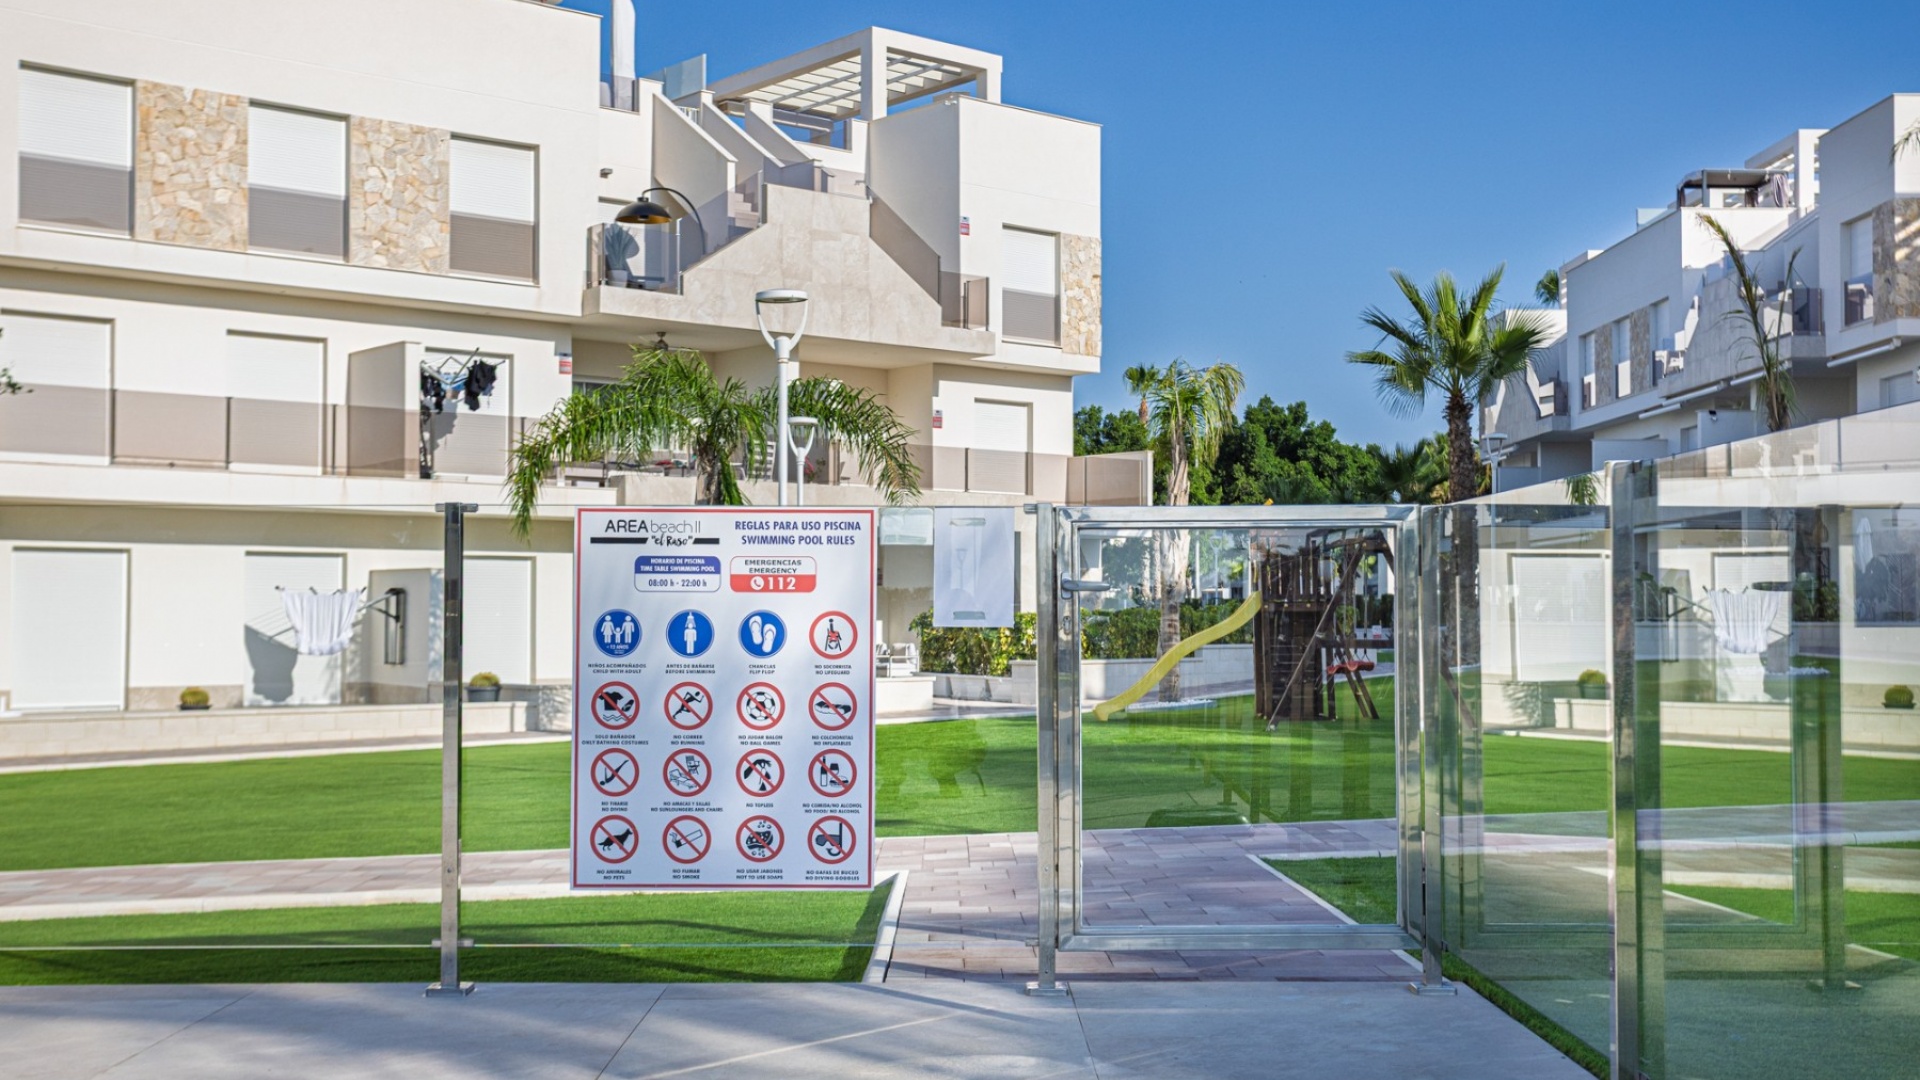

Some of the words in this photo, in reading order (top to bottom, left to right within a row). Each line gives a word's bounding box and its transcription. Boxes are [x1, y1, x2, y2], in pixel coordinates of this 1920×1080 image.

[605, 520, 648, 532] AREA
[651, 520, 693, 533] beach
[735, 521, 770, 530] REGLAS
[773, 521, 798, 530] PARA
[802, 521, 820, 530] USO
[824, 521, 861, 530] PISCINA
[742, 536, 795, 545] SWIMMING
[798, 536, 823, 545] POOL
[826, 536, 855, 545] RULES
[768, 577, 796, 590] 112
